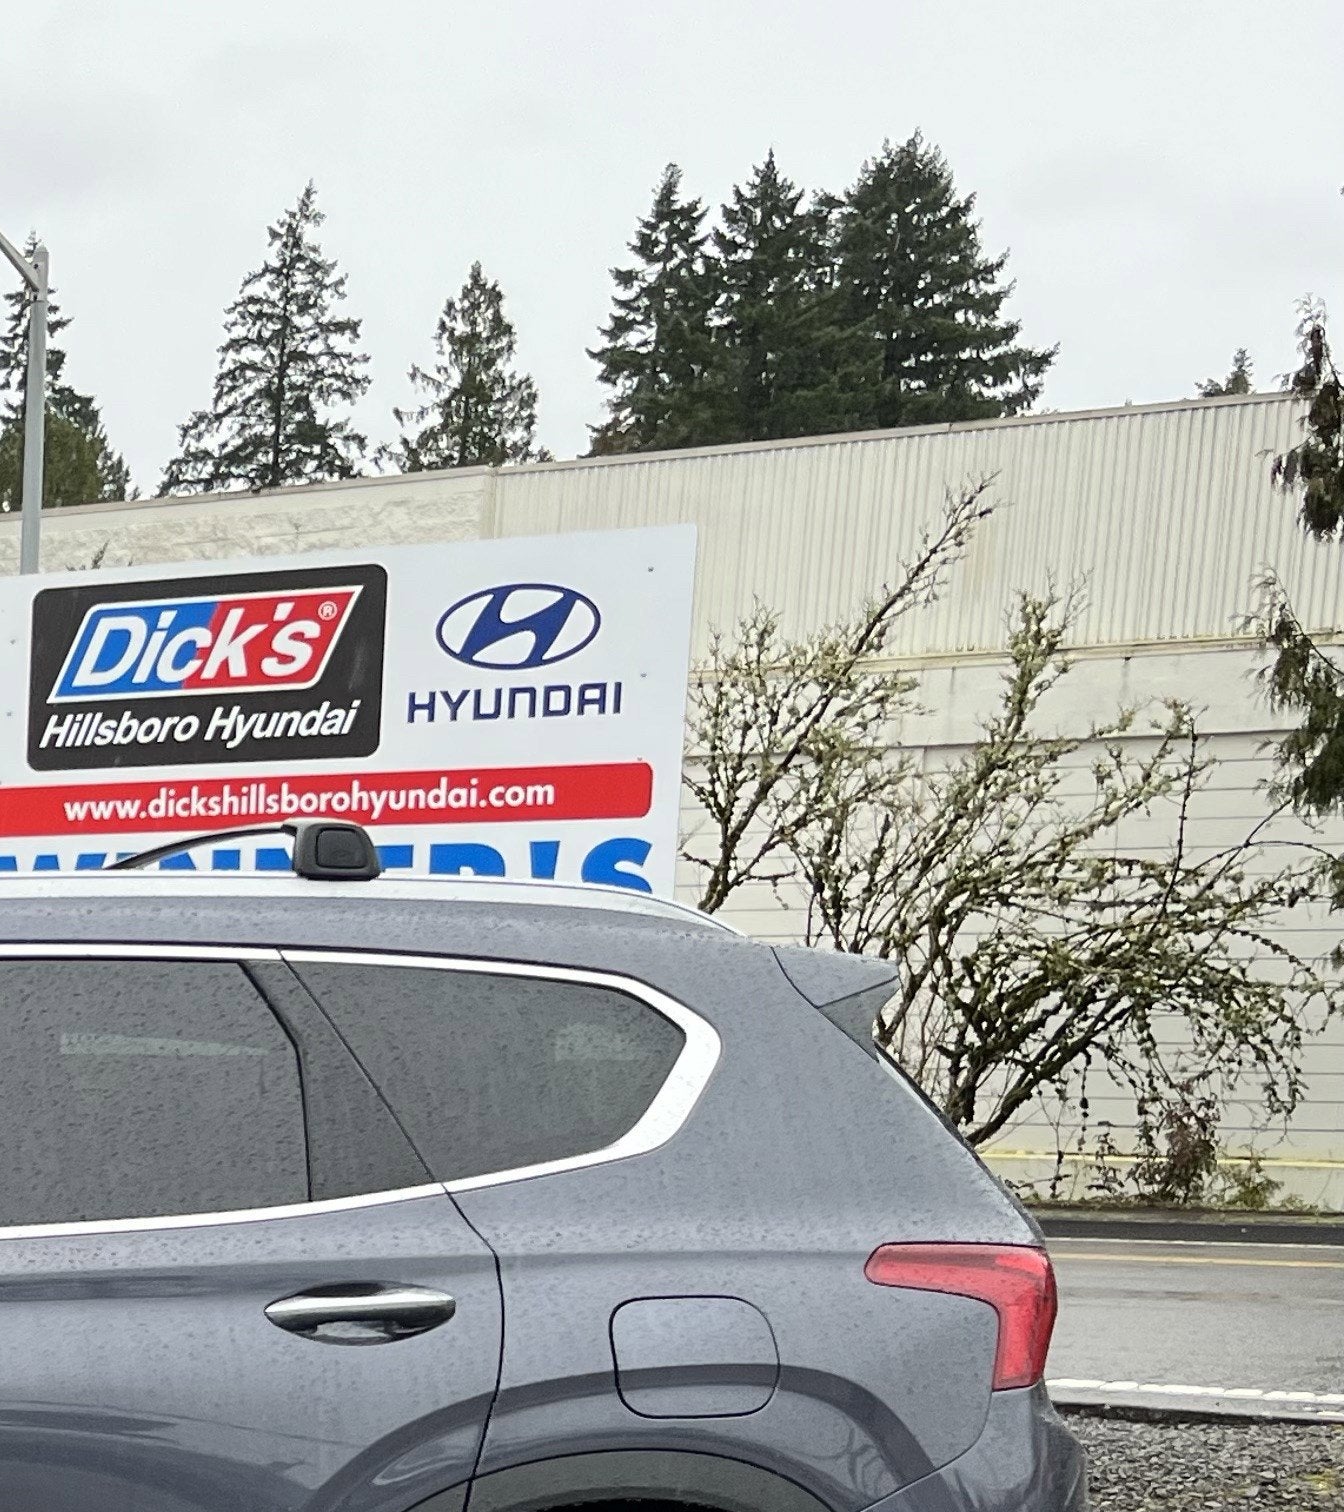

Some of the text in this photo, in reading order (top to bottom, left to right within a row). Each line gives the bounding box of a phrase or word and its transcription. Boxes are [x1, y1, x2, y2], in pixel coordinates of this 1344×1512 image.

[71, 602, 322, 689] Dick's
[39, 699, 362, 749] Hillsboro Hyundai
[406, 681, 622, 724] HYUNDAI
[63, 776, 556, 822] www.dickshillsborohyundai.com
